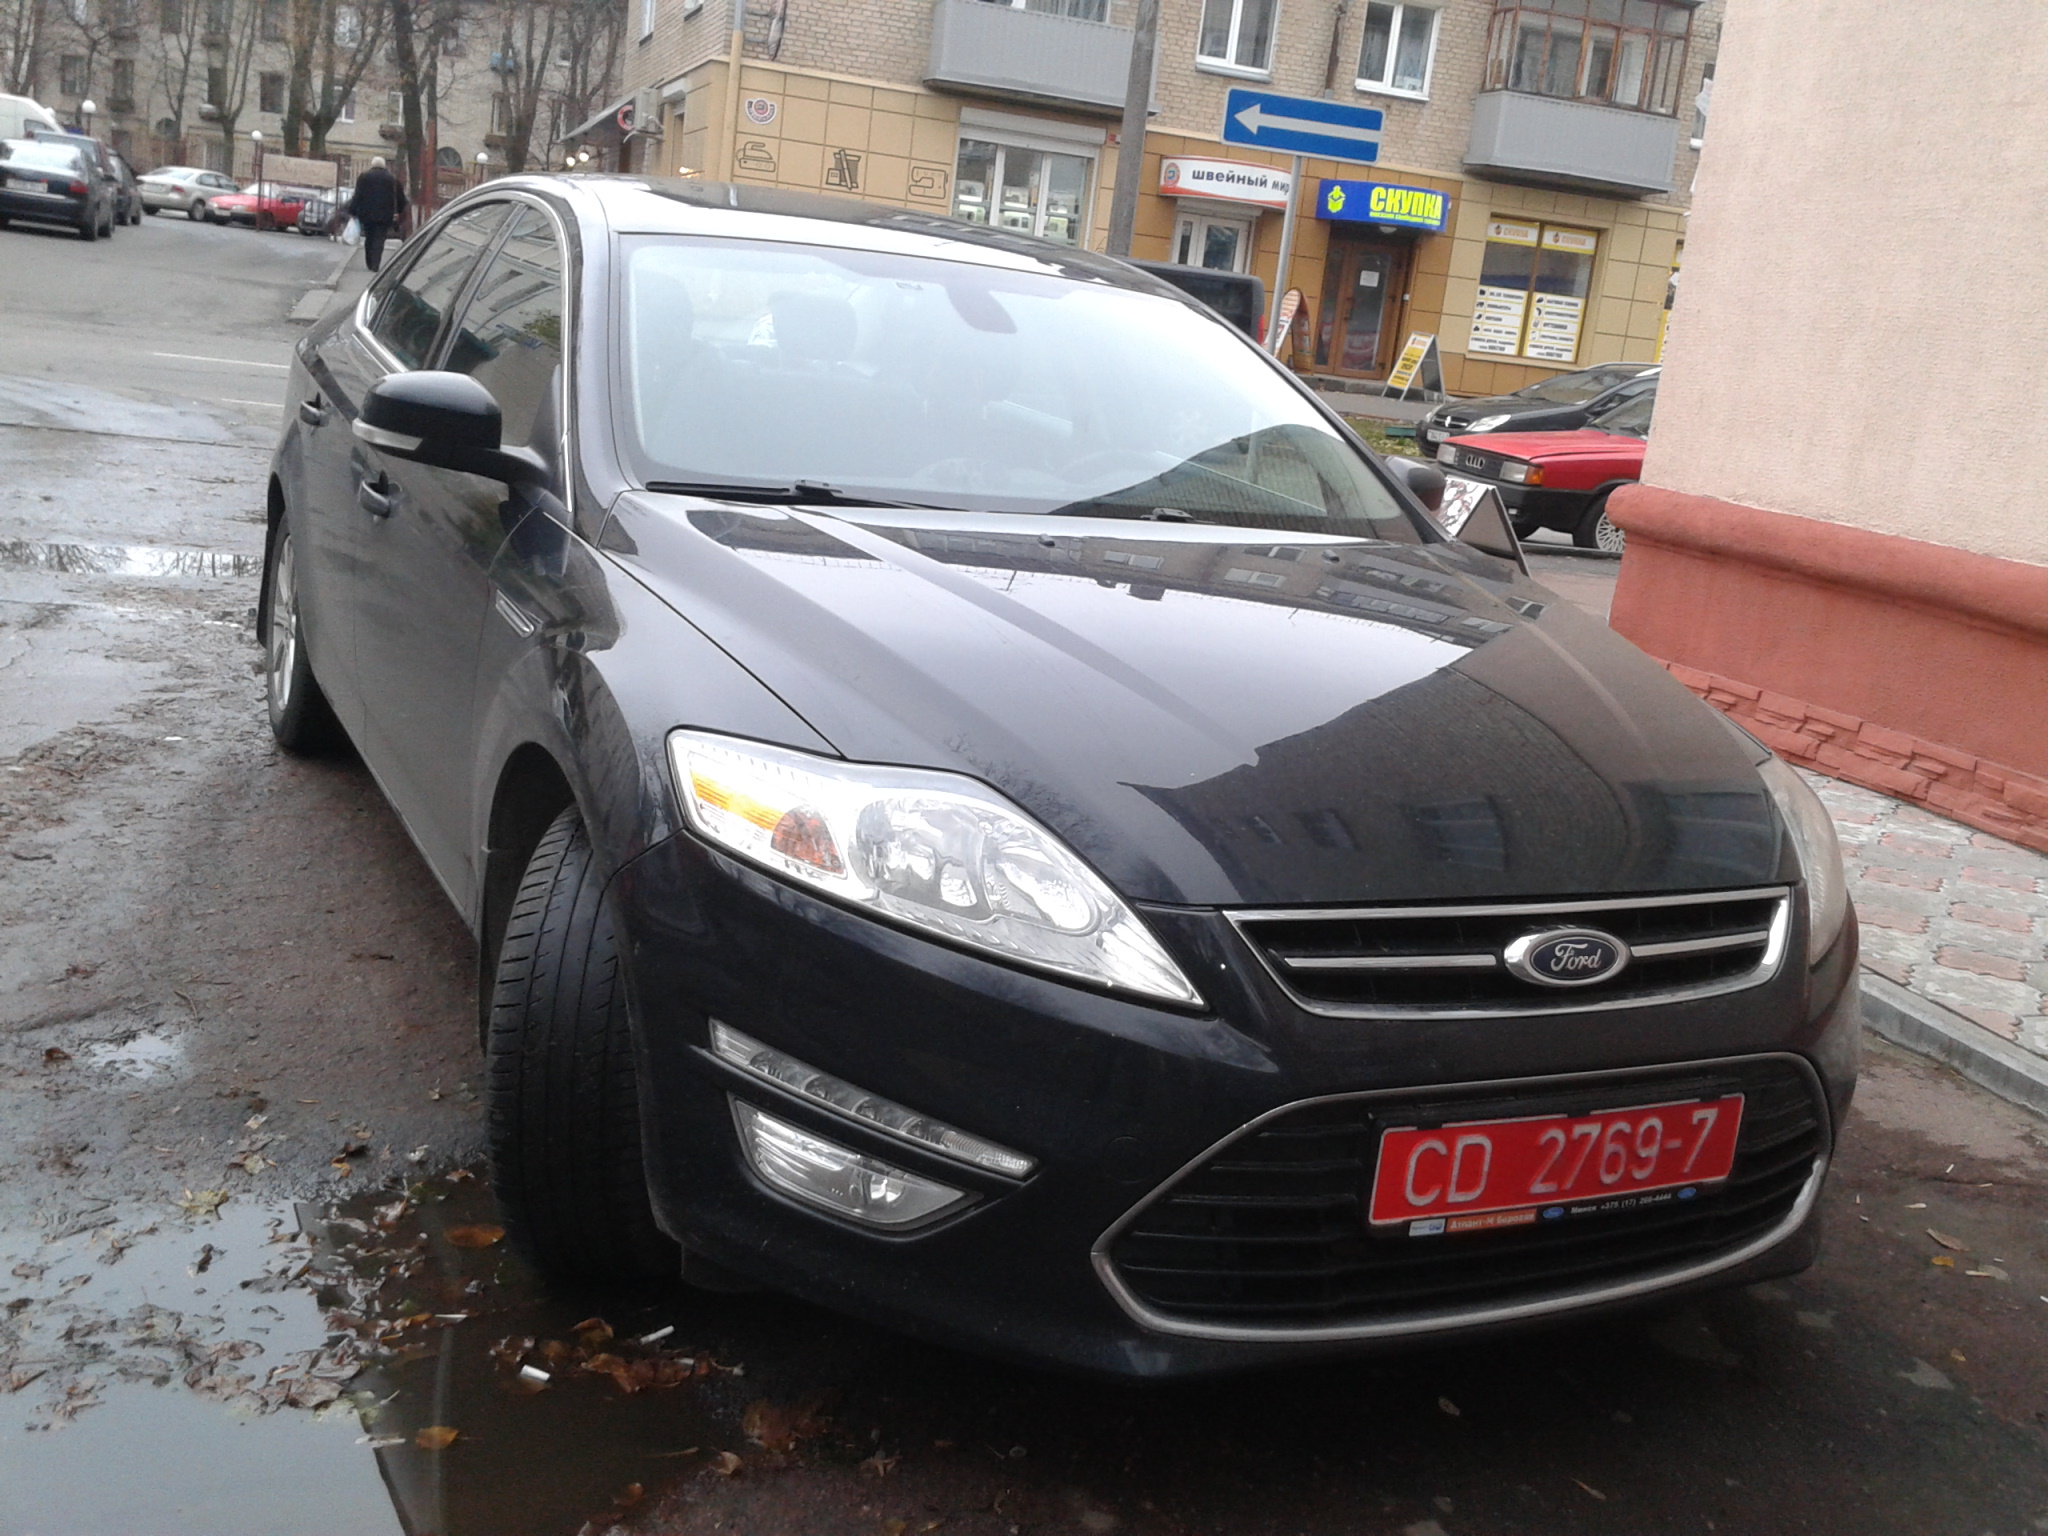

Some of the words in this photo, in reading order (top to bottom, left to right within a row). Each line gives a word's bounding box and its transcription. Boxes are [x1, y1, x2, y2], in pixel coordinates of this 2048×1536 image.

[1191, 170, 1268, 188] швейный
[1369, 186, 1443, 220] СКУПКА
[1550, 943, 1602, 972] Ford
[1404, 1134, 1493, 1207] CD
[1529, 1107, 1719, 1195] 2769-7
